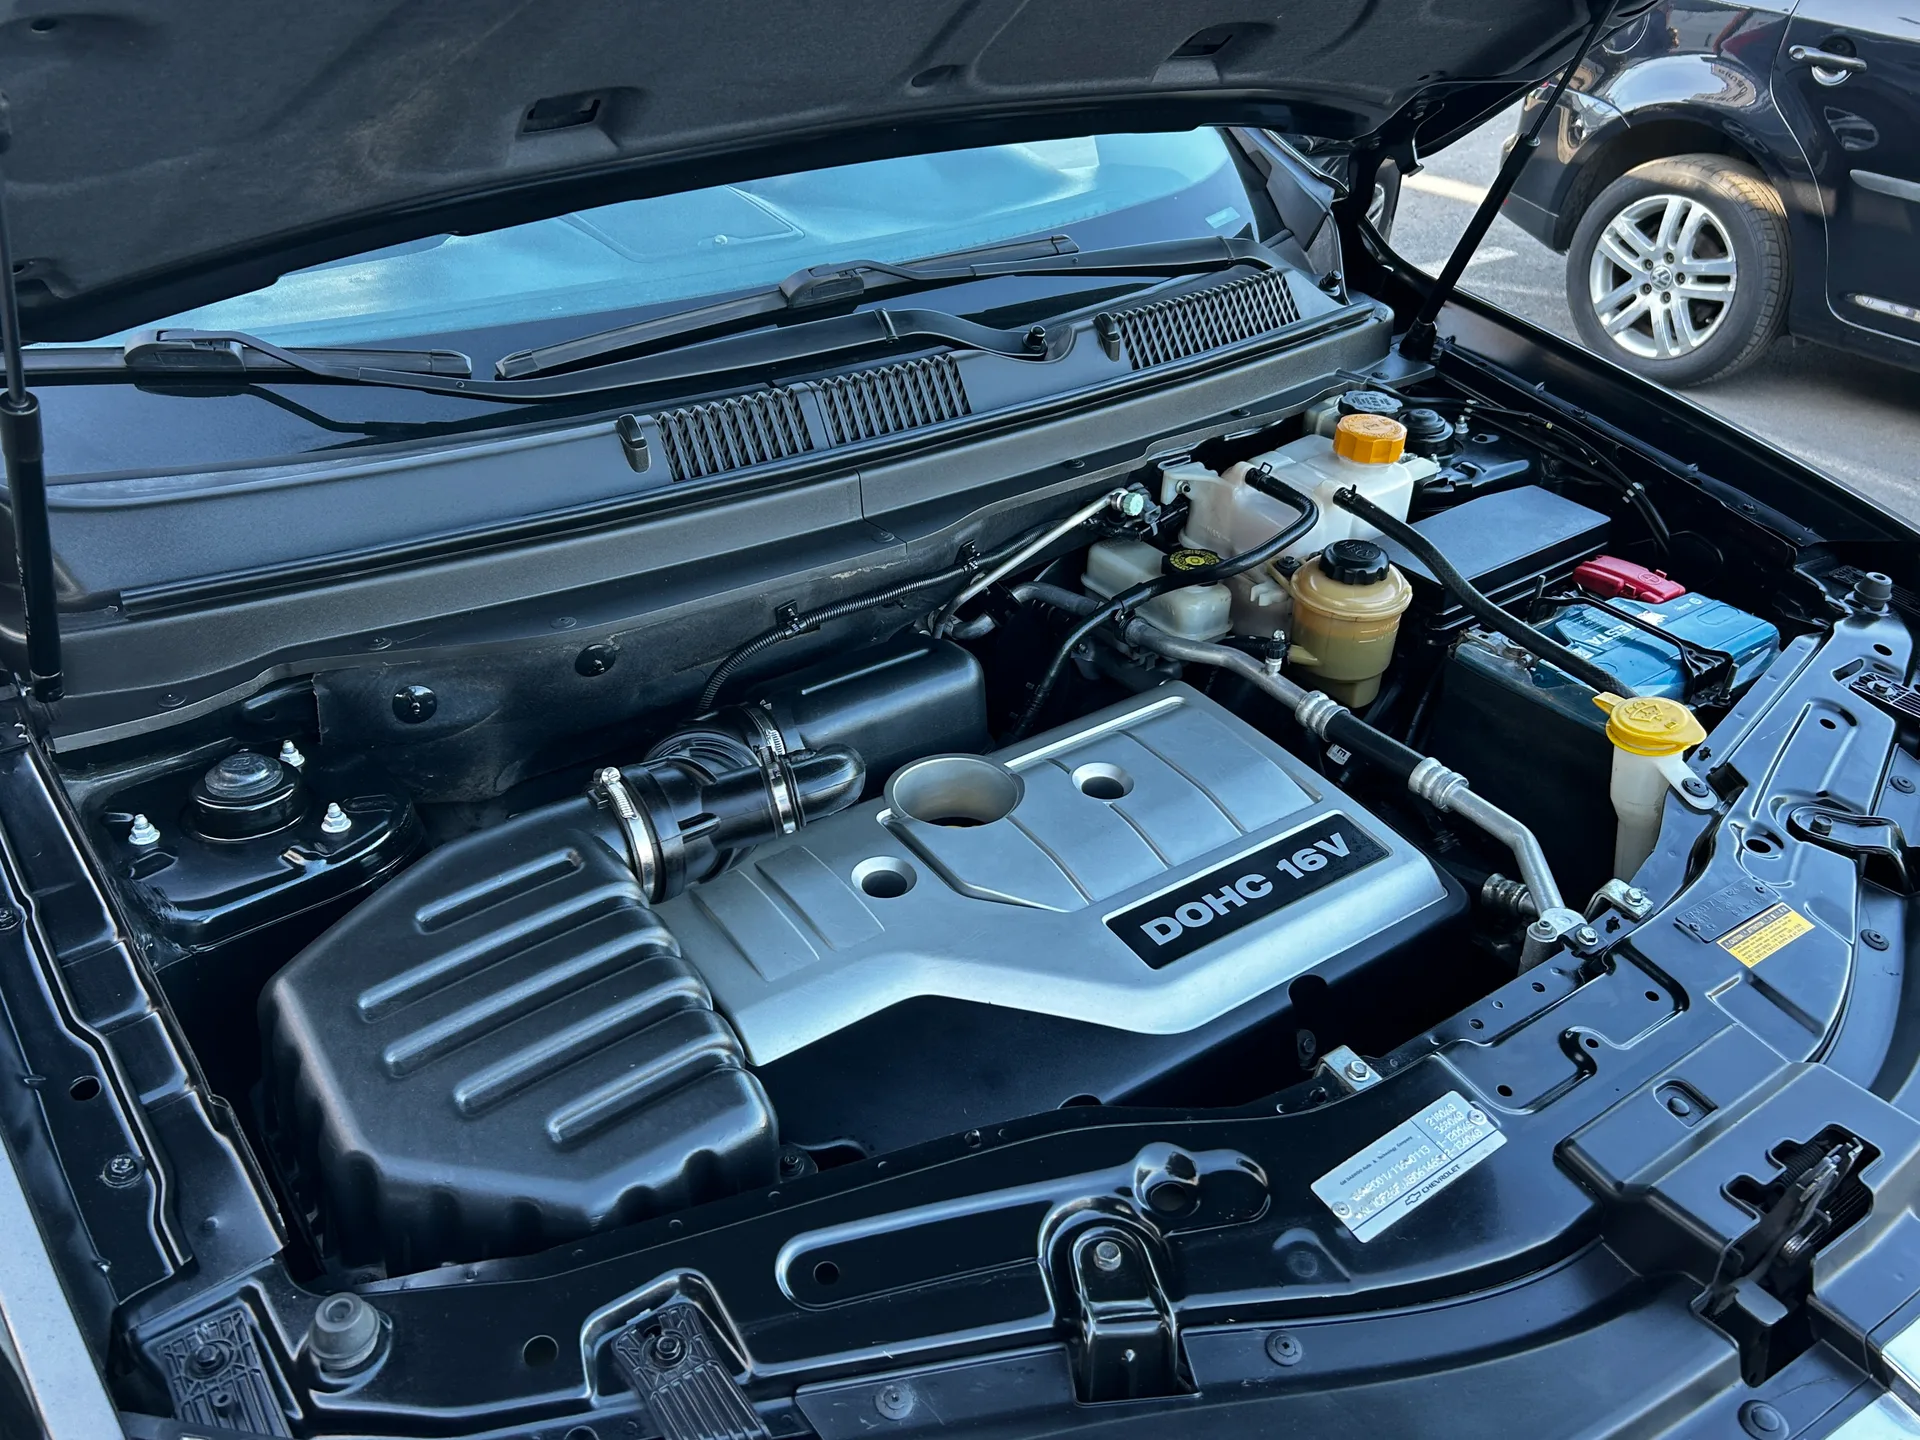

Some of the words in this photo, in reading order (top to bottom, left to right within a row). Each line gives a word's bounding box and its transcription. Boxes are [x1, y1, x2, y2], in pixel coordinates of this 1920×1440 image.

[1140, 874, 1273, 946] DOHC
[1276, 832, 1351, 880] 16V
[1421, 1163, 1461, 1194] CHEVROLET
